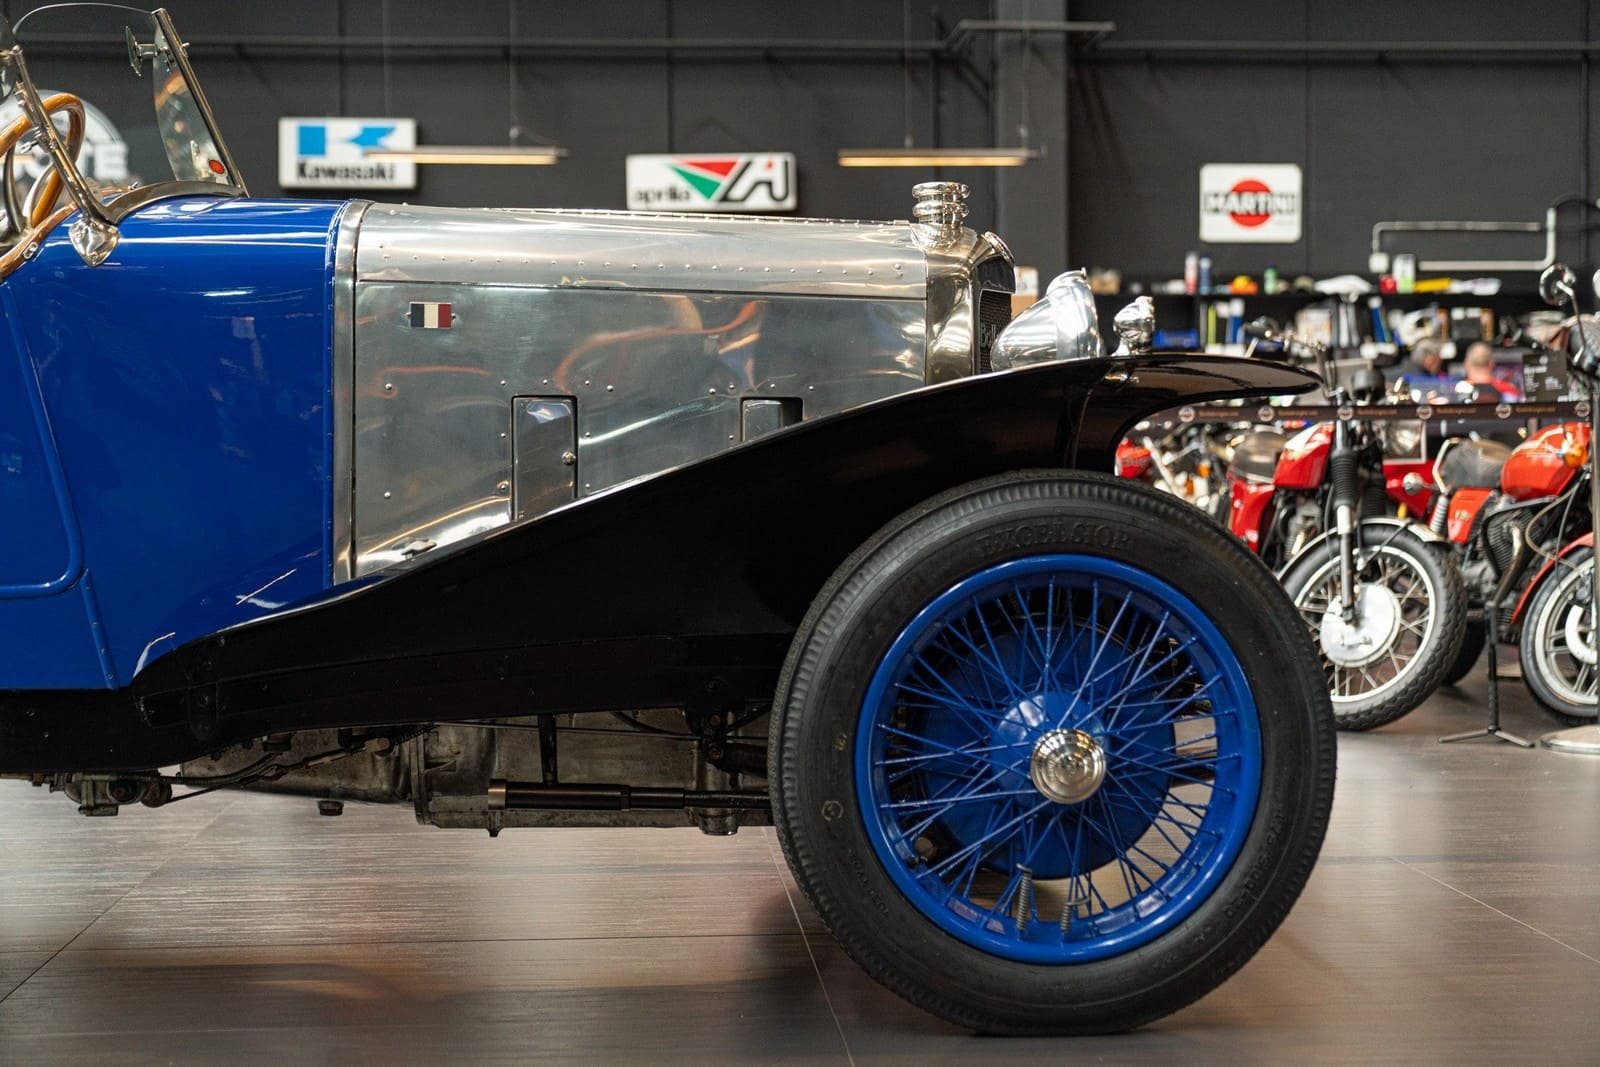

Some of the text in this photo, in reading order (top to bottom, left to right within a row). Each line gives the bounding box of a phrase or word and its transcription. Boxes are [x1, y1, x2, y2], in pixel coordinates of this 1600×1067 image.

[297, 161, 394, 179] Kawasaki
[636, 185, 691, 204] aprilia
[1202, 191, 1297, 214] MARTINI
